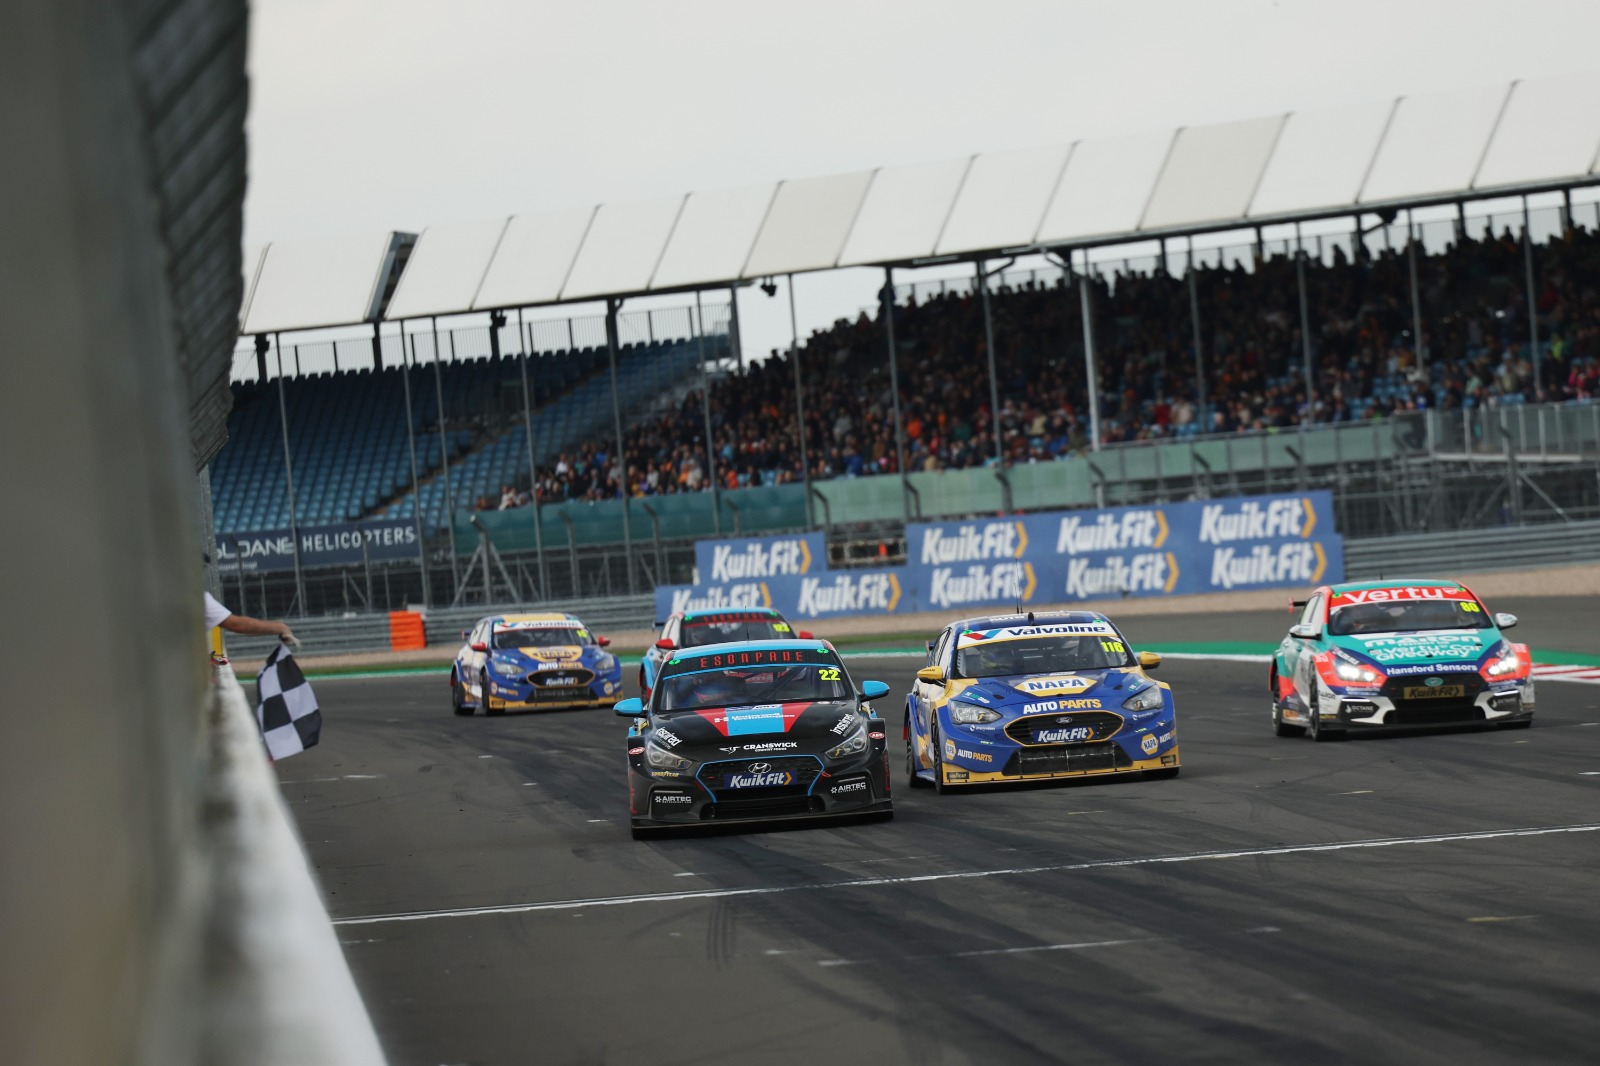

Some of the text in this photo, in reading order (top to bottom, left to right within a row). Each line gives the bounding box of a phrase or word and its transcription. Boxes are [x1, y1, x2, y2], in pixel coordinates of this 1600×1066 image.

[1200, 498, 1302, 545] KwikFit
[1057, 511, 1157, 555] KwikFit
[921, 522, 1016, 566] KwikFit
[711, 540, 801, 583] KwikFit
[1211, 542, 1315, 589] KwikFit
[1066, 552, 1167, 599] KwikFit
[797, 573, 890, 616] KwikFit
[1459, 601, 1480, 613] 80
[1008, 624, 1106, 637] Valvoline
[1101, 641, 1125, 653] 116
[818, 669, 841, 681] 22
[1386, 663, 1478, 676] Hansford Sensors
[1027, 677, 1086, 691] NAPA
[1023, 698, 1102, 715] AUTO PARTS
[1037, 728, 1088, 742] KwikFit
[743, 741, 798, 751] CRANSWICK
[957, 748, 973, 759] AUTO
[972, 751, 993, 763] PARTS
[730, 771, 786, 789] KwikFit
[838, 782, 867, 793] AIRTEC
[662, 795, 692, 803] AIRTEC
